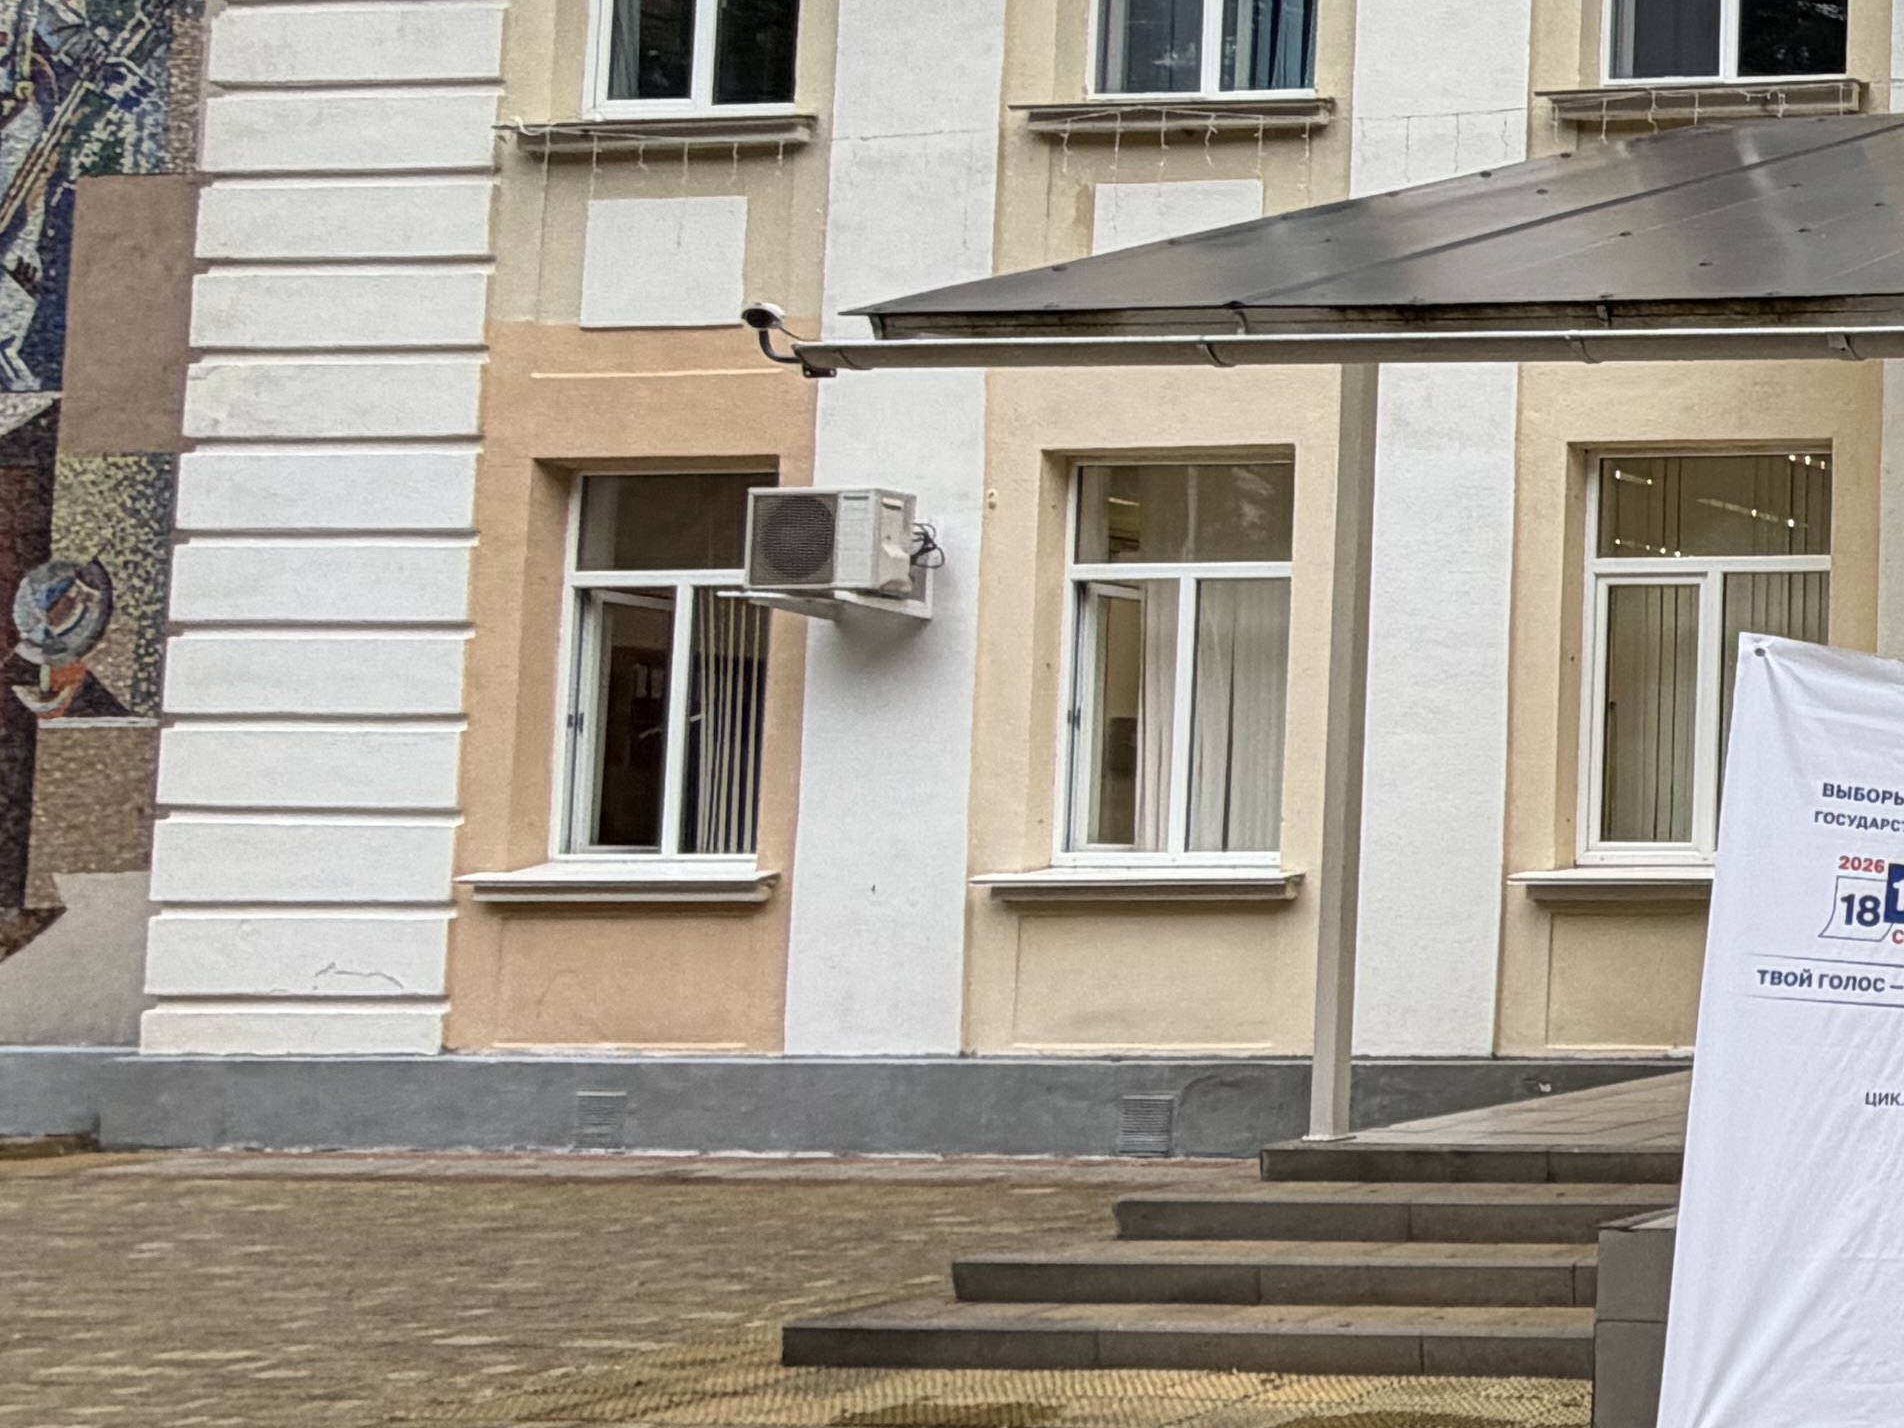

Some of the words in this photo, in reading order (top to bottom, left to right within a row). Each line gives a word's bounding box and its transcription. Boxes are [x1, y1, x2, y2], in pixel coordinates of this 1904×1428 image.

[1838, 855, 1885, 874] 2026
[1840, 893, 1881, 927] 18
[1756, 968, 1813, 988] ТВОЙ
[1817, 973, 1886, 993] ГОЛОС
